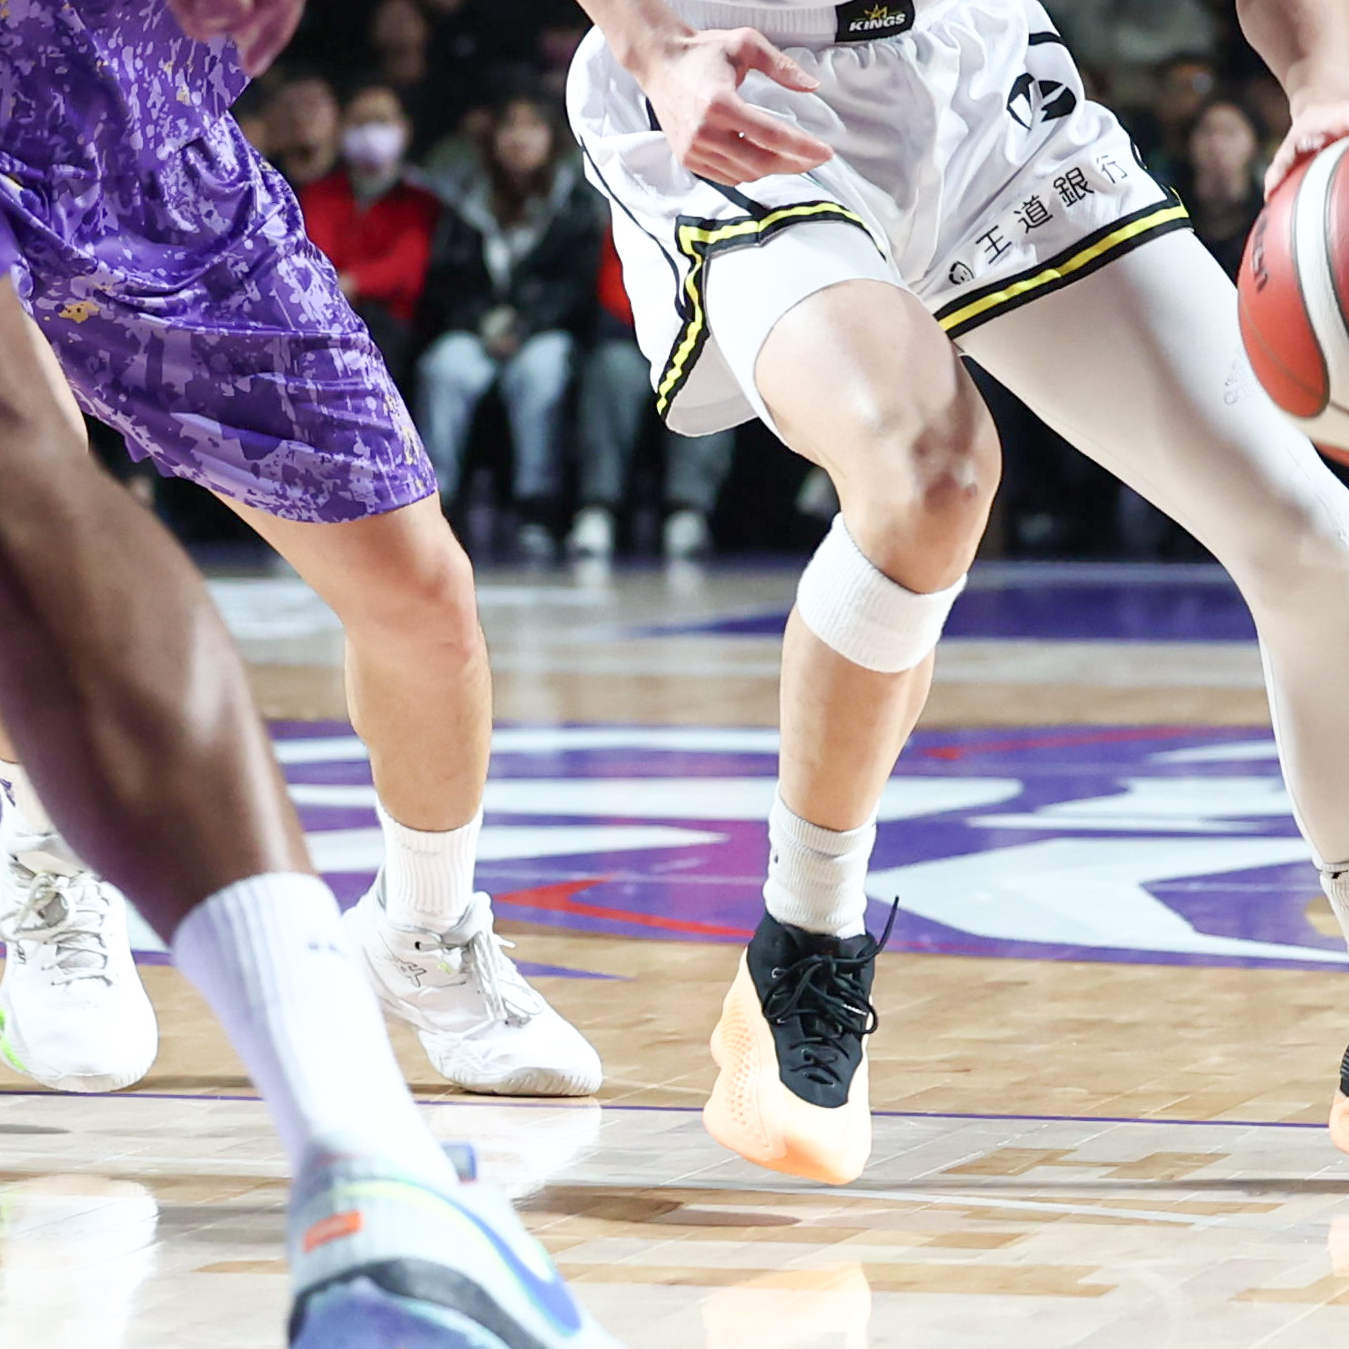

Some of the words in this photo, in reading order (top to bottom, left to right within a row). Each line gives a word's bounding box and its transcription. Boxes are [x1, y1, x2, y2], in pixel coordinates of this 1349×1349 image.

[848, 13, 907, 32] KINGS
[975, 154, 1129, 265] 王道銀行
